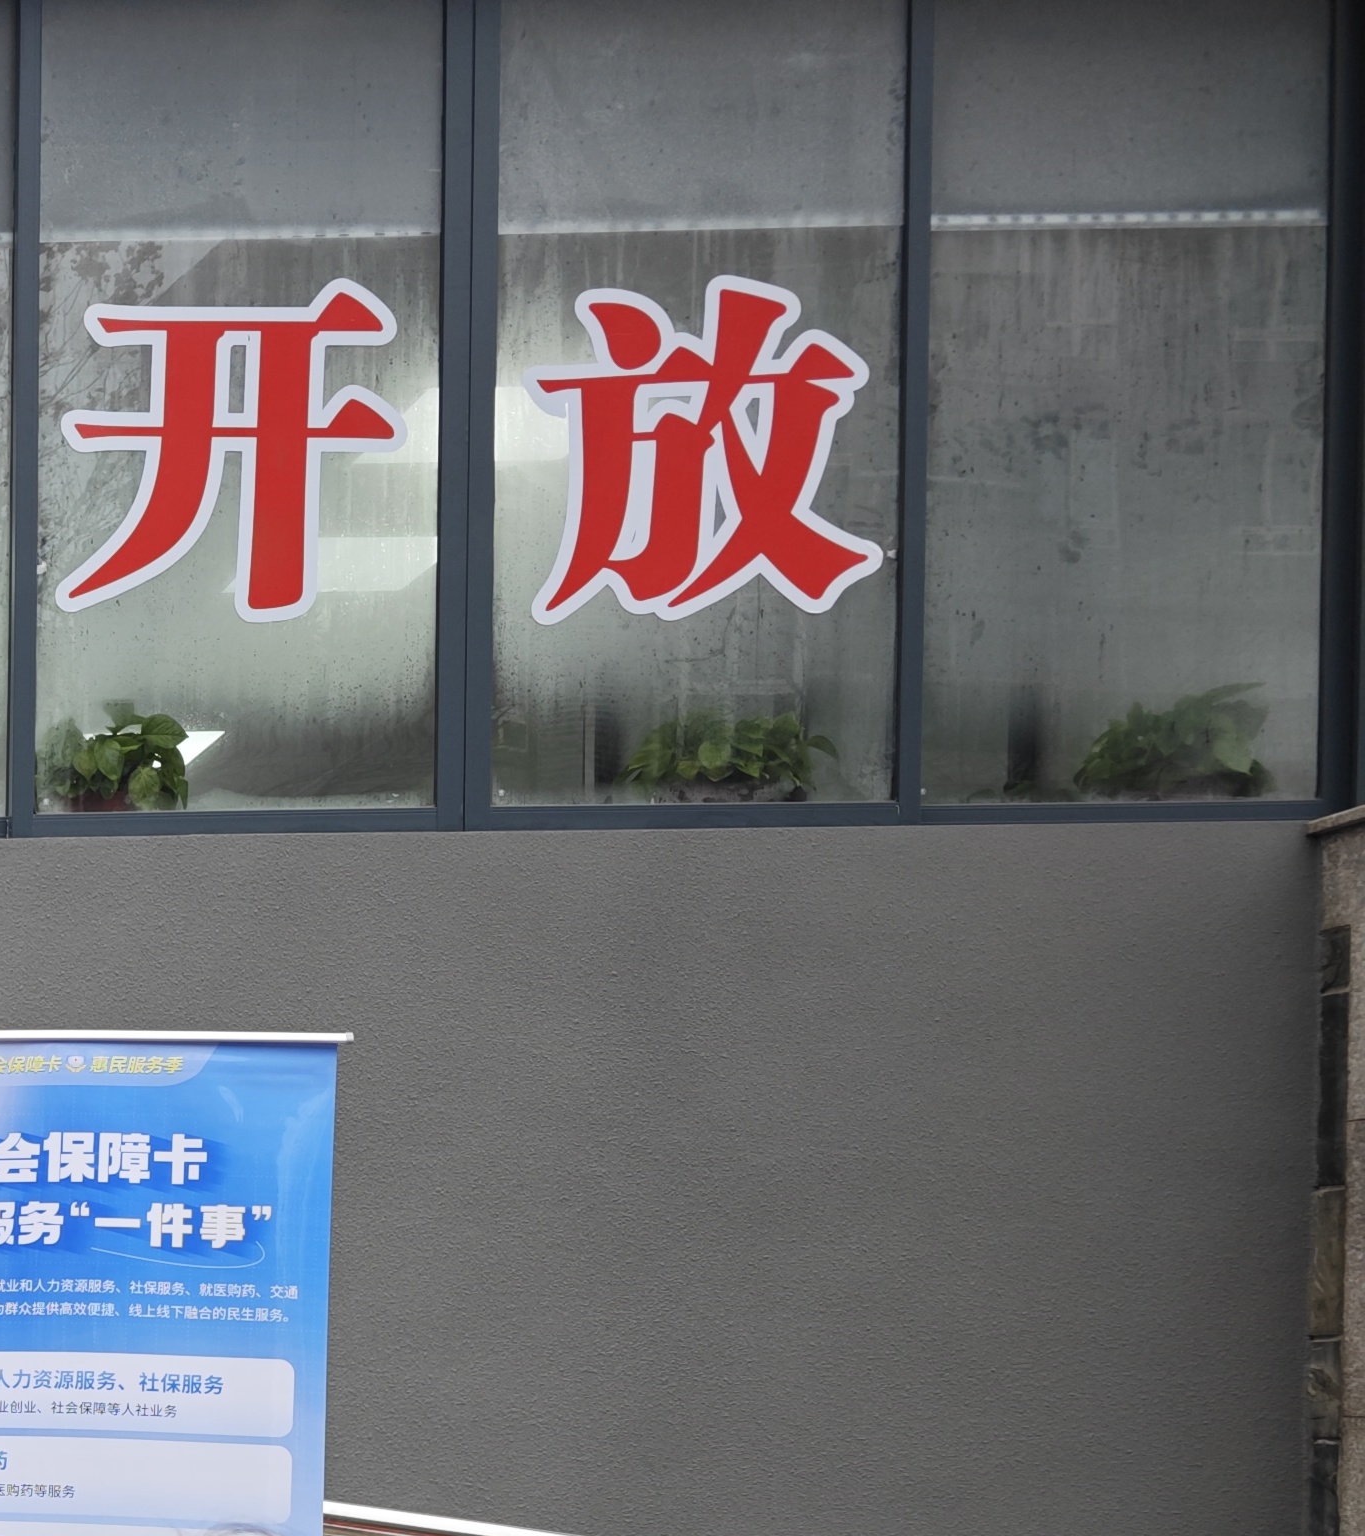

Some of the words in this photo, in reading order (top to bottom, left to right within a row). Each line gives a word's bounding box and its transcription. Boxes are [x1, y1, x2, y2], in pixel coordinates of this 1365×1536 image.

[89, 1055, 185, 1075] 惠民服务季
